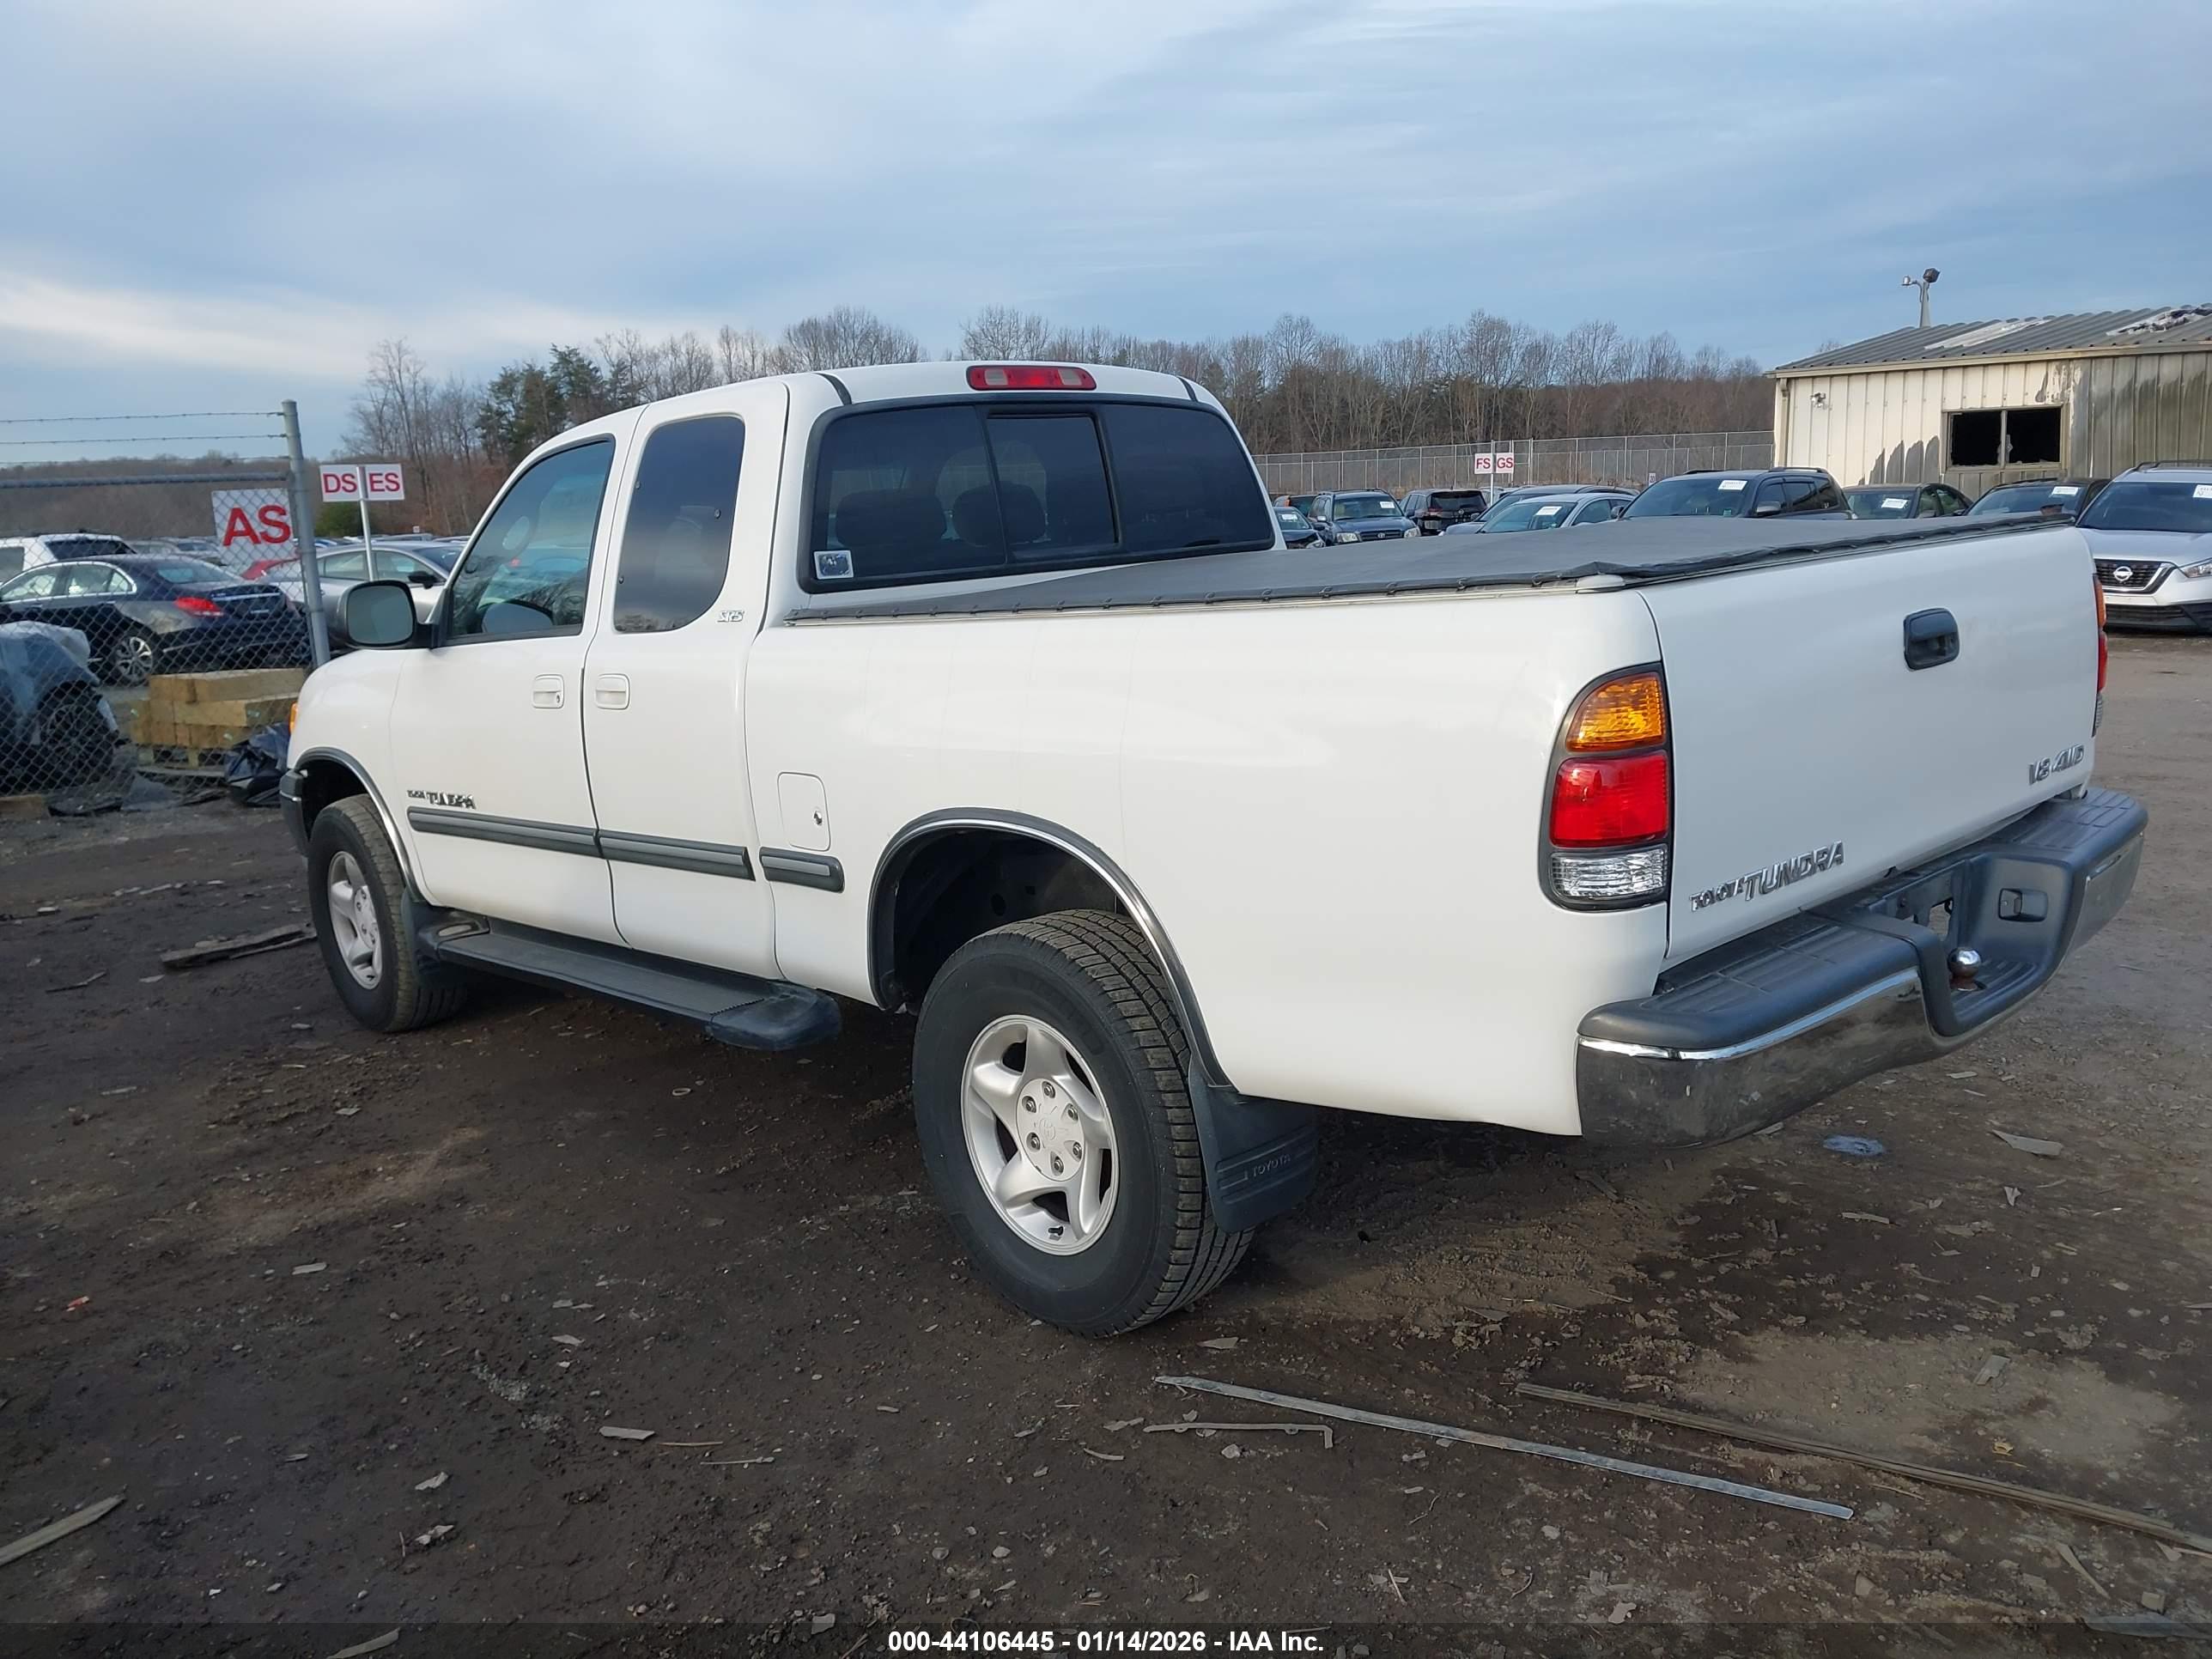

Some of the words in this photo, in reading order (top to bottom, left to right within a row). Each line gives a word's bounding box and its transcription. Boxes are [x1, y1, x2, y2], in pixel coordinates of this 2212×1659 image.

[1476, 458, 1491, 469] FS
[1497, 457, 1513, 469] GS
[322, 473, 357, 493] DS
[369, 472, 400, 492] ES
[222, 505, 291, 546] AS
[1743, 840, 1844, 902] TUNDRA
[1253, 1154, 1291, 1177] TOYOTA
